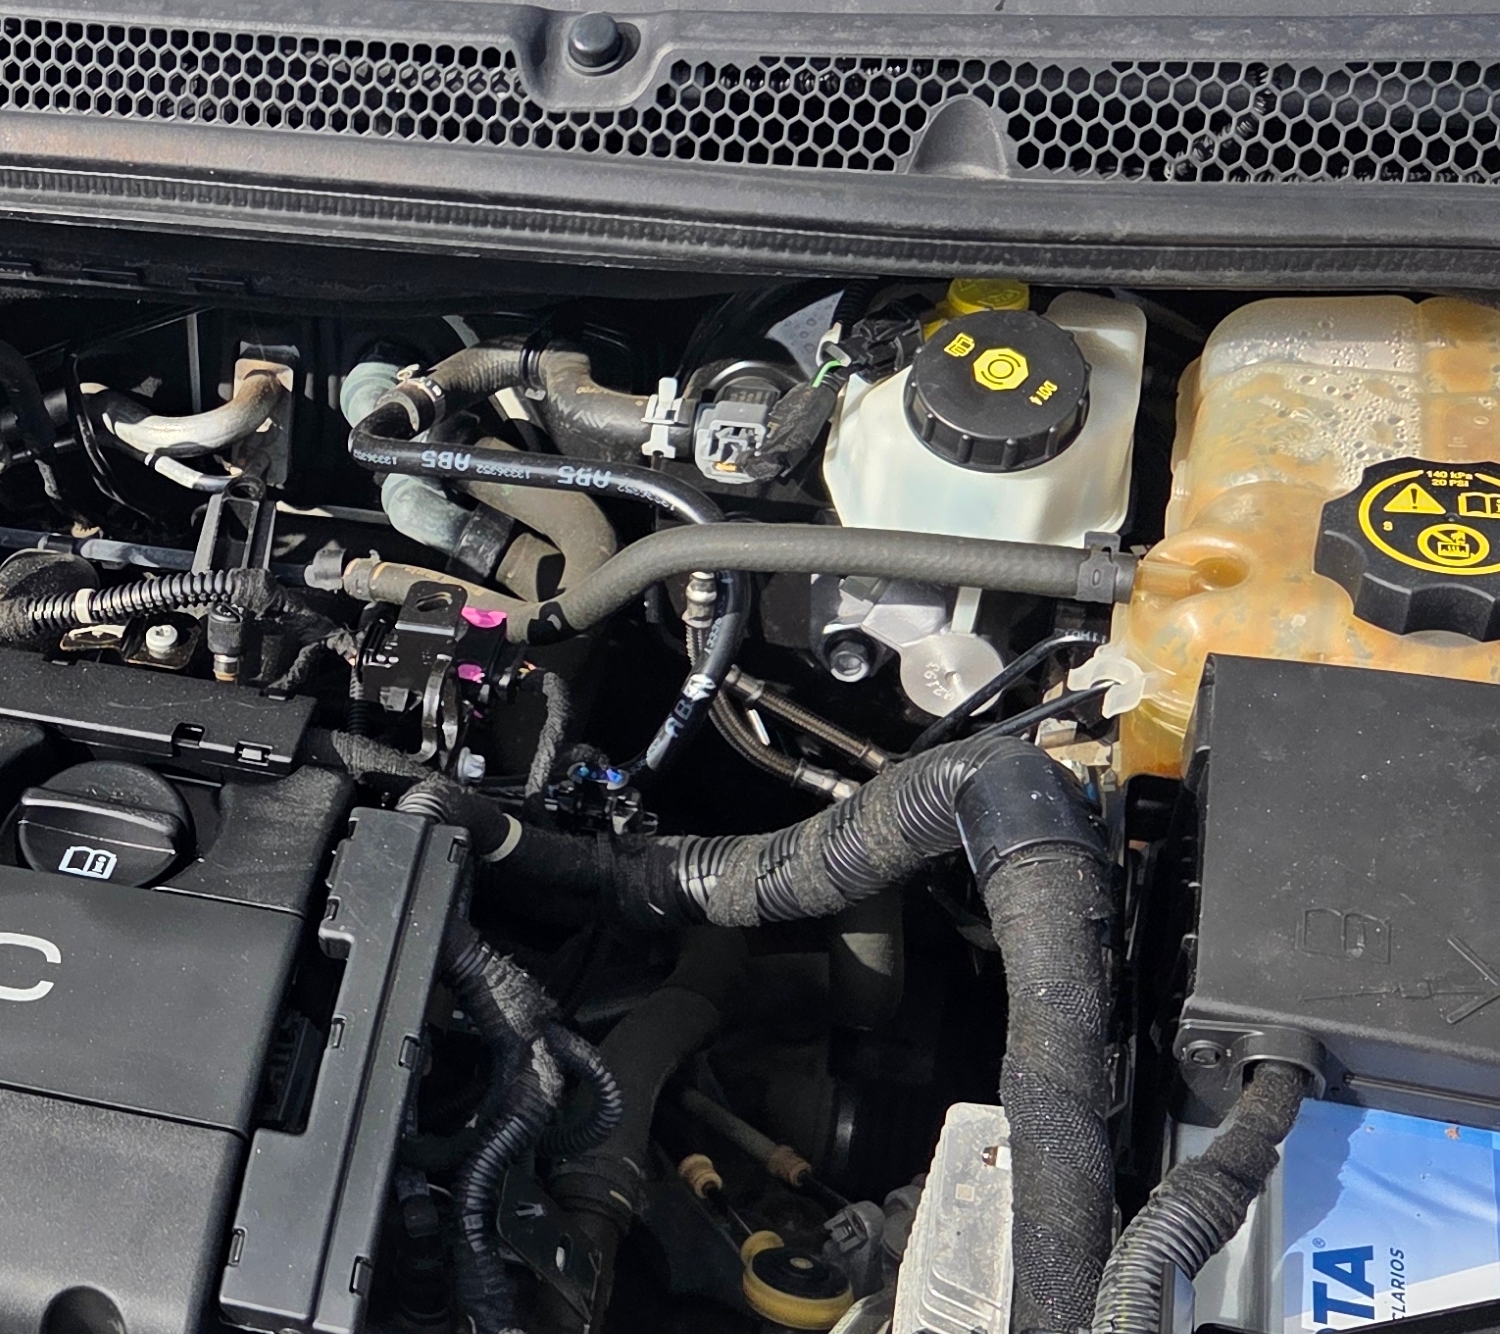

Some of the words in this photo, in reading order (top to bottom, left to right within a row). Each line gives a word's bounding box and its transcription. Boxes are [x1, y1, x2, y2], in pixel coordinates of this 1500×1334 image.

[1037, 379, 1058, 401] DOT
[1030, 395, 1043, 406] 4
[1426, 470, 1448, 480] 140
[1449, 471, 1473, 481] kPa
[1431, 478, 1447, 487] 20
[1448, 478, 1470, 488] PSI
